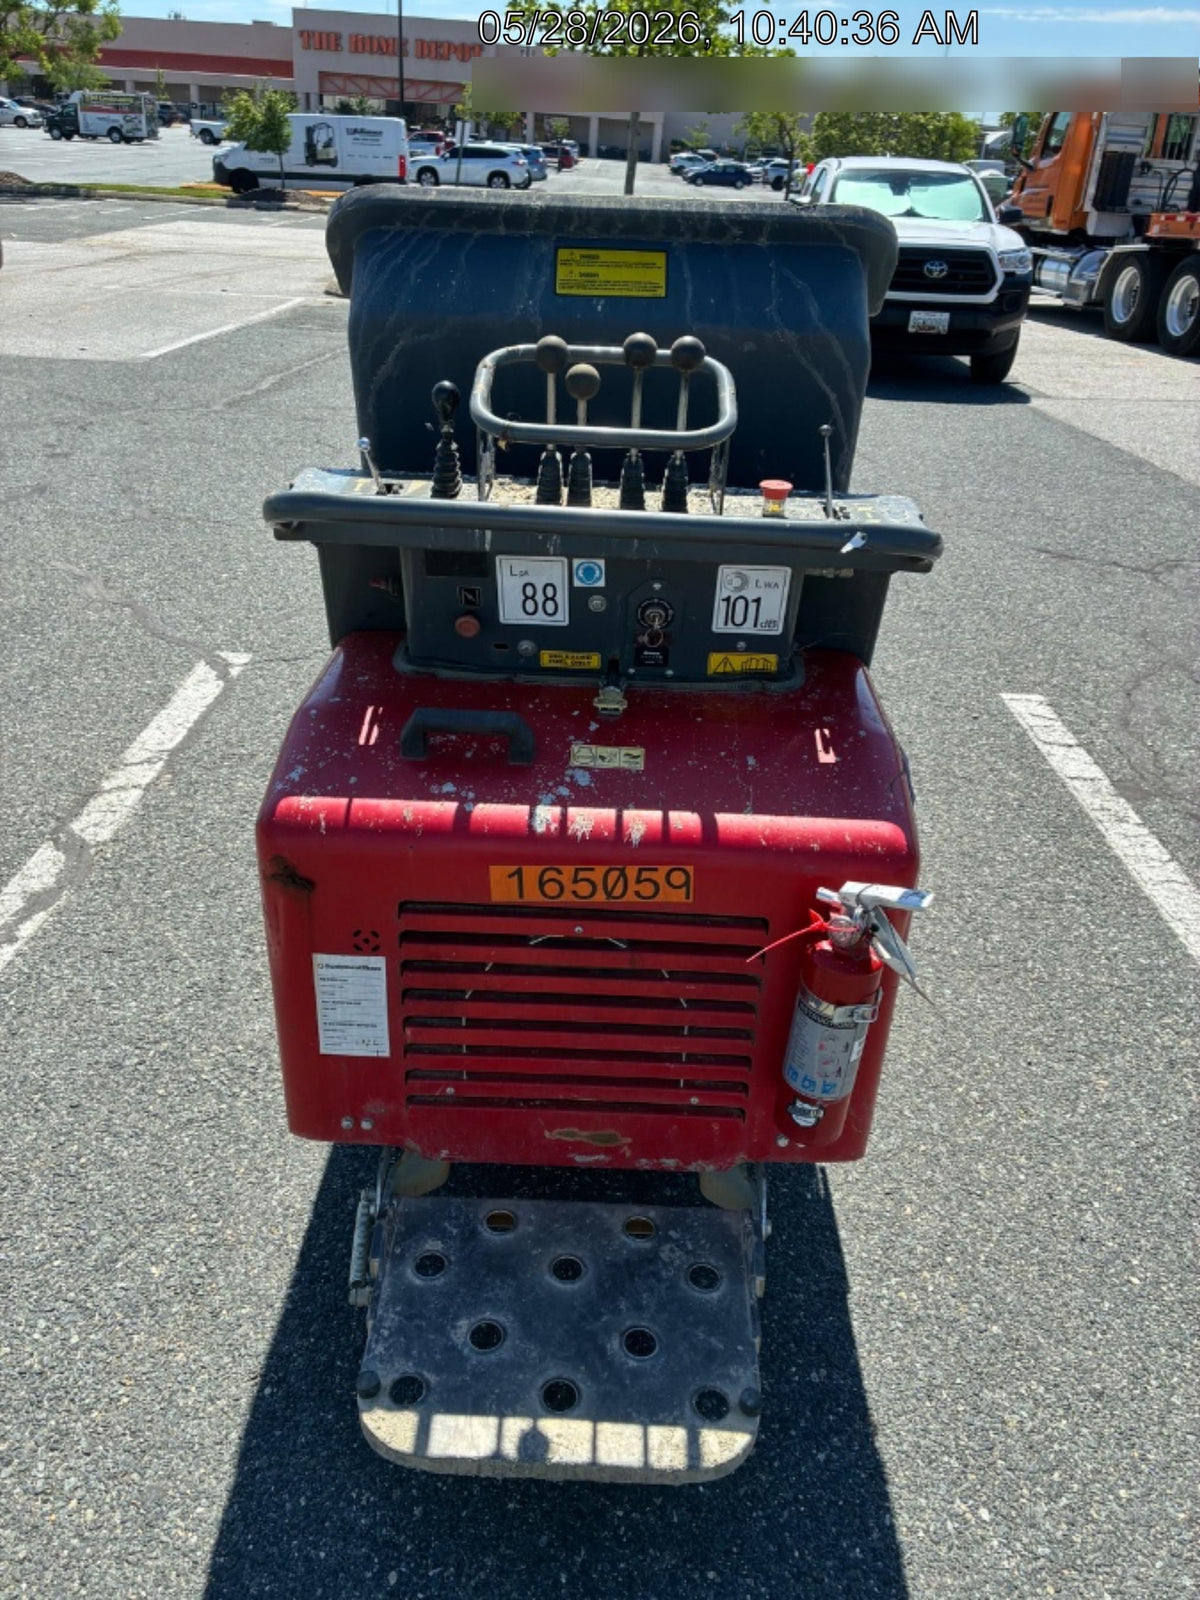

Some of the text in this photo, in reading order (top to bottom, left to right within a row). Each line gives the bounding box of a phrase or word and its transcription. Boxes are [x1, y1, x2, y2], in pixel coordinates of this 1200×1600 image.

[299, 30, 484, 62] THE HOME DEPOT
[522, 582, 559, 617] 88
[721, 595, 762, 628] 101
